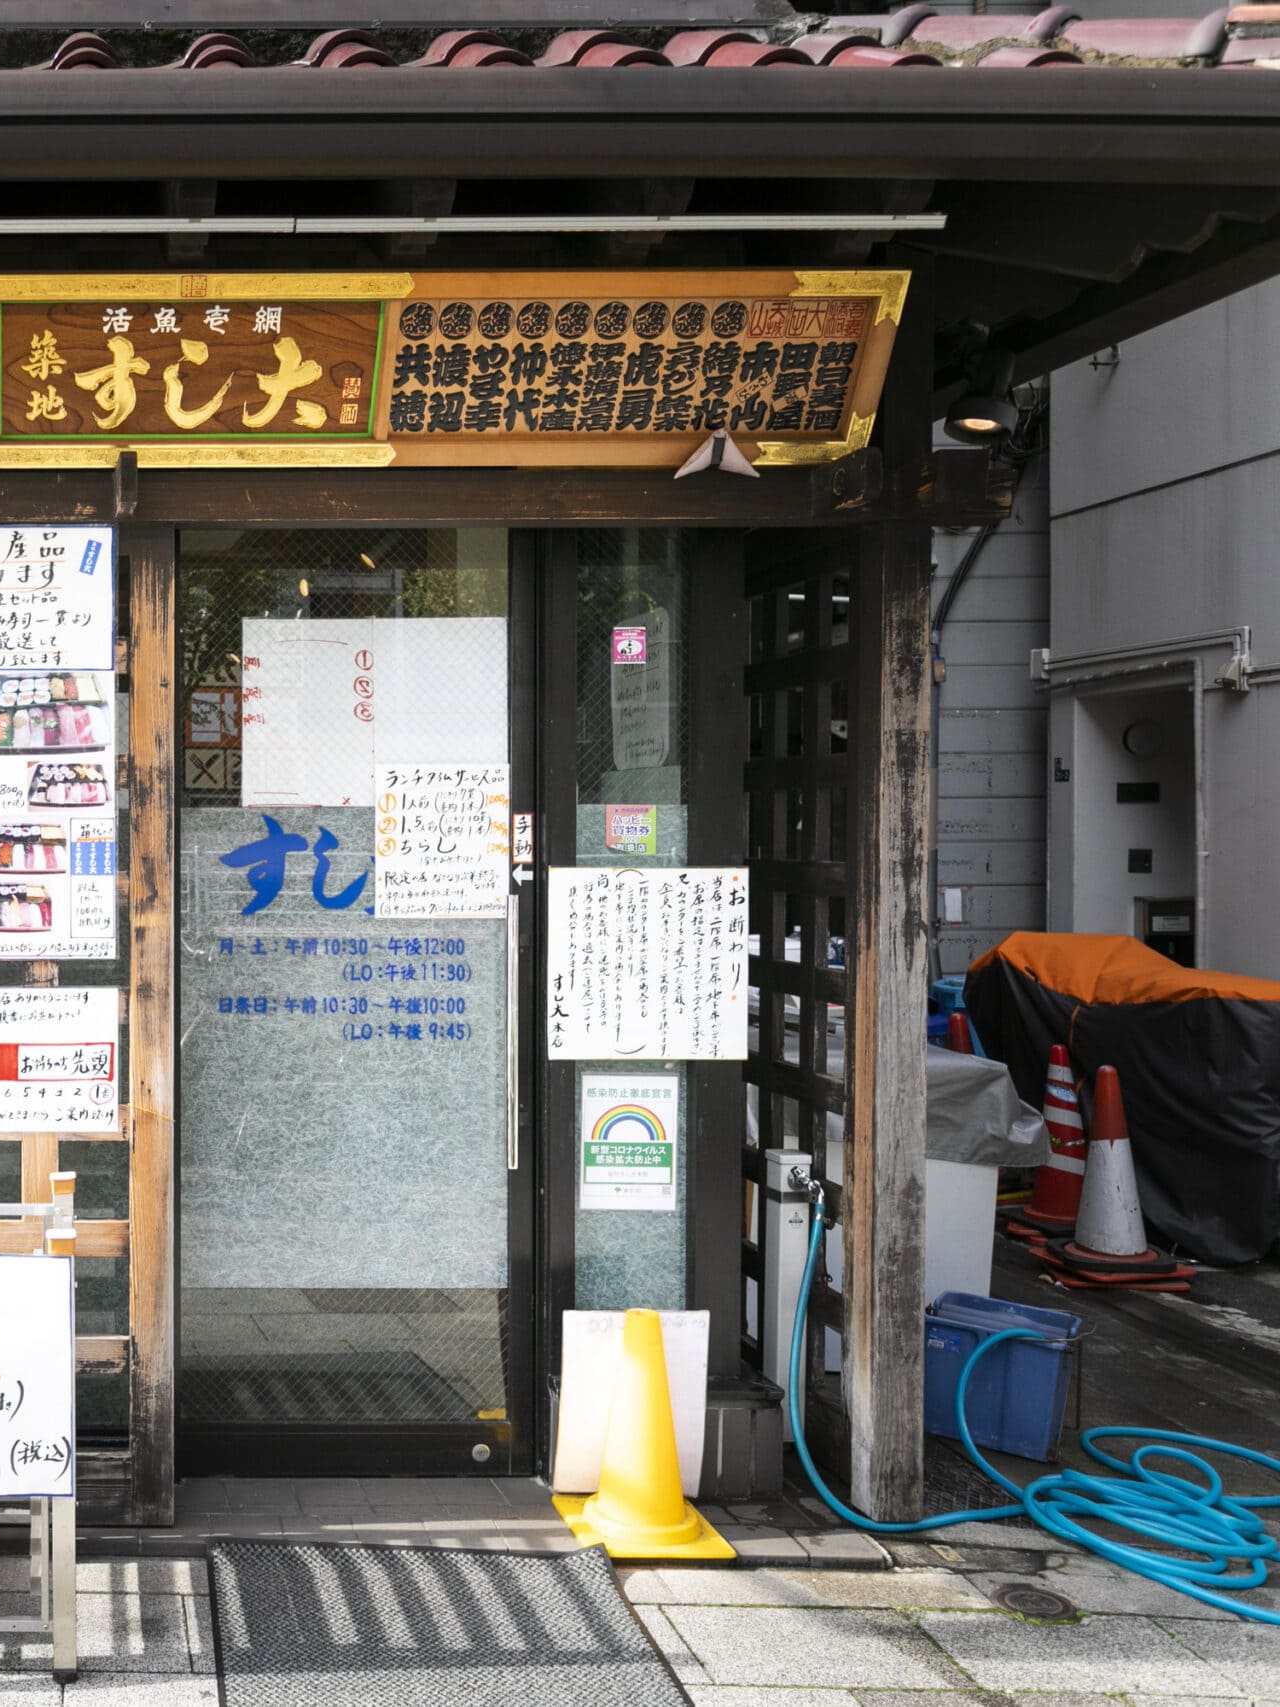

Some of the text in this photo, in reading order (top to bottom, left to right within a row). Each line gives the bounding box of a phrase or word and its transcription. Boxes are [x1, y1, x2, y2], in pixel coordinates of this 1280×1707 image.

[21, 330, 68, 422] 築地
[75, 336, 328, 430] すし大
[220, 814, 375, 916] すし
[401, 836, 457, 856] ちらし
[515, 816, 533, 858] 手動
[728, 884, 746, 991] お断わり
[590, 1145, 667, 1155] 新型コロナウイルス
[10, 1436, 71, 1481] (税込)
